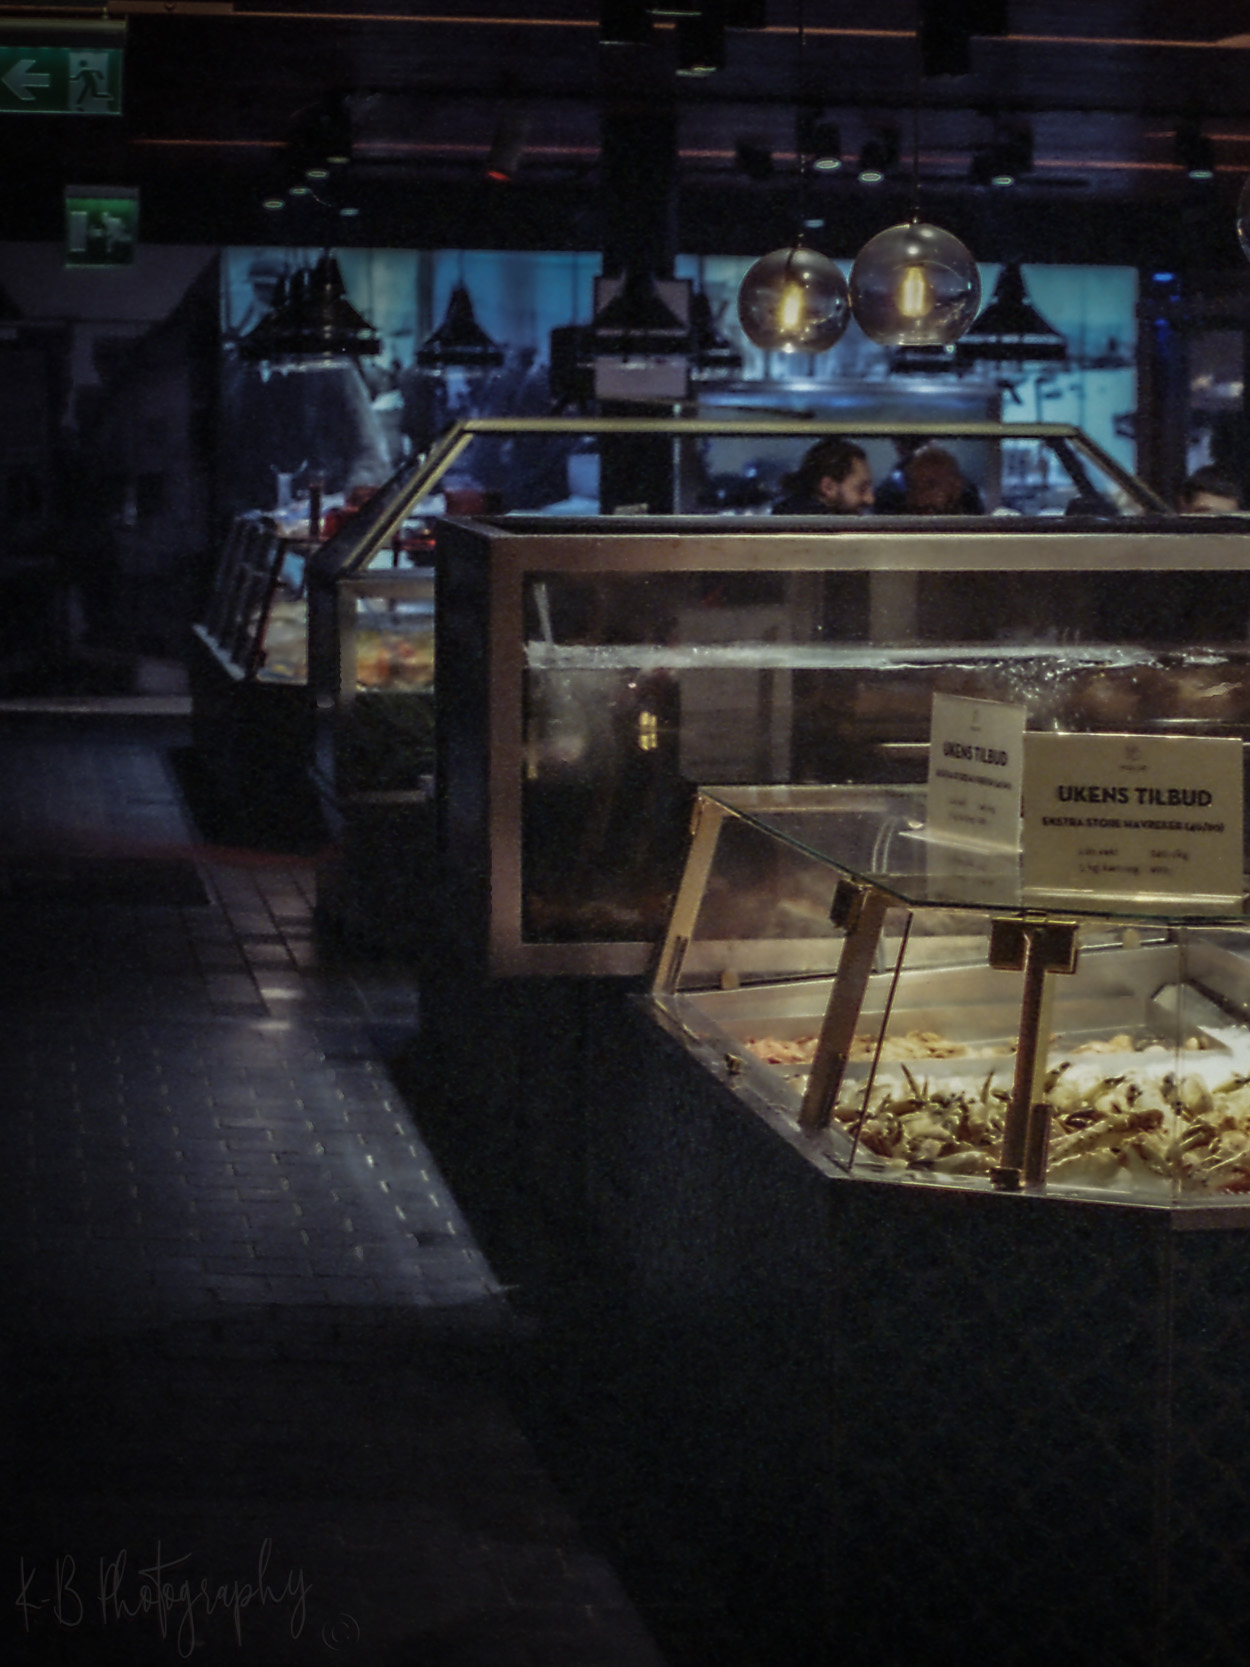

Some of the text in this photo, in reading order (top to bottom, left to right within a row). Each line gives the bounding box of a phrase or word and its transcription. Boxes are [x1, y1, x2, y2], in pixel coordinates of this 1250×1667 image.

[943, 741, 1008, 767] UKENS TILBUD
[1057, 785, 1212, 807] UKENS TILBUD
[1042, 816, 1083, 827] EKSTRA
